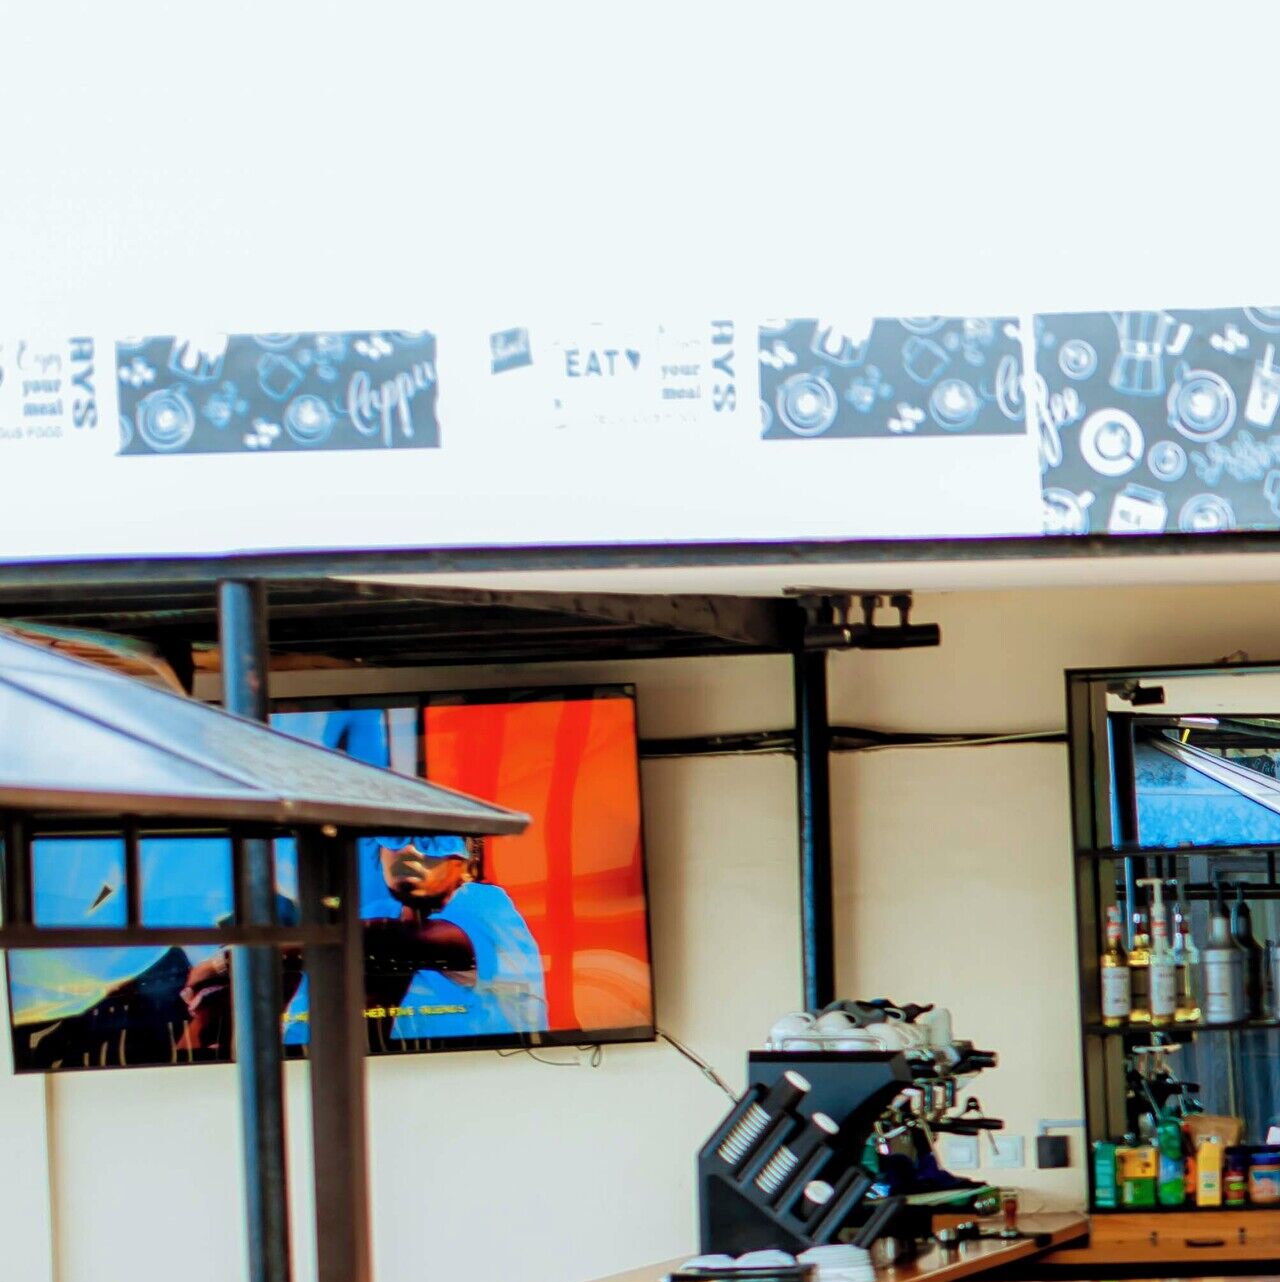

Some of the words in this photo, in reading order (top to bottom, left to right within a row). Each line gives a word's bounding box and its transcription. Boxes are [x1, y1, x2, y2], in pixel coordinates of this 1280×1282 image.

[564, 348, 620, 378] EAT
[659, 363, 701, 380] your
[22, 379, 62, 398] your
[661, 384, 702, 401] meal
[23, 398, 63, 417] meal
